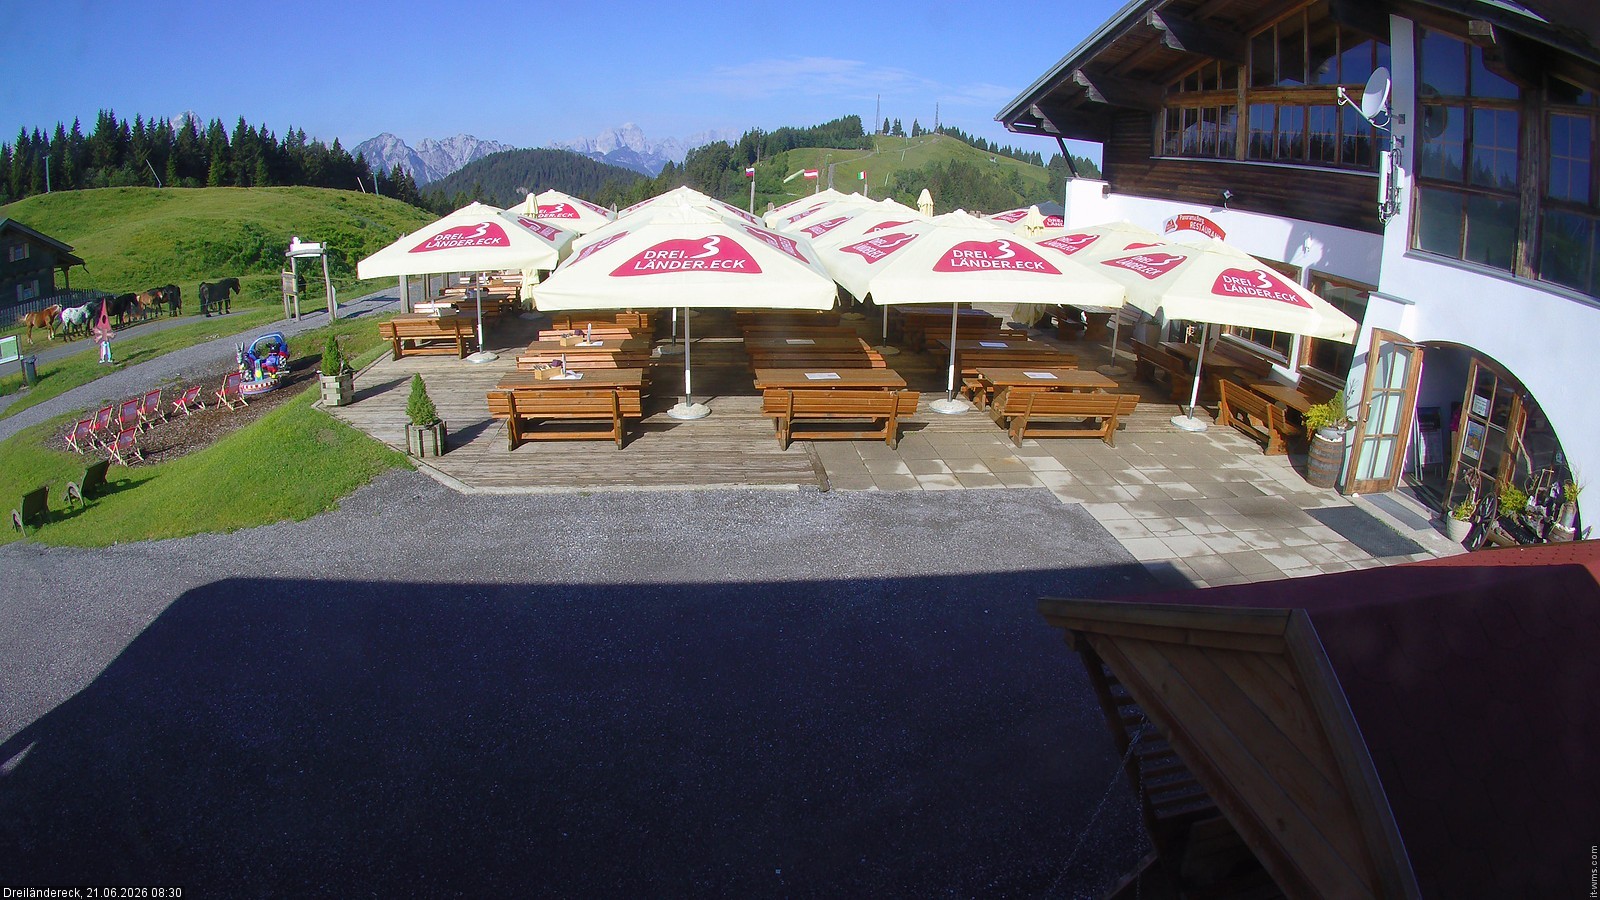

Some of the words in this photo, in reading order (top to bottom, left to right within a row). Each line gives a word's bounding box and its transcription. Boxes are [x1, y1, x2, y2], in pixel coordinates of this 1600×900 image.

[644, 250, 688, 259] DREI.
[952, 249, 992, 259] DREI.
[634, 259, 746, 270] LÄNDER.ECK
[950, 258, 1045, 270] LÄNDER.ECK
[1222, 275, 1256, 287] DREI.
[1223, 283, 1299, 303] LÄNDER.ECK
